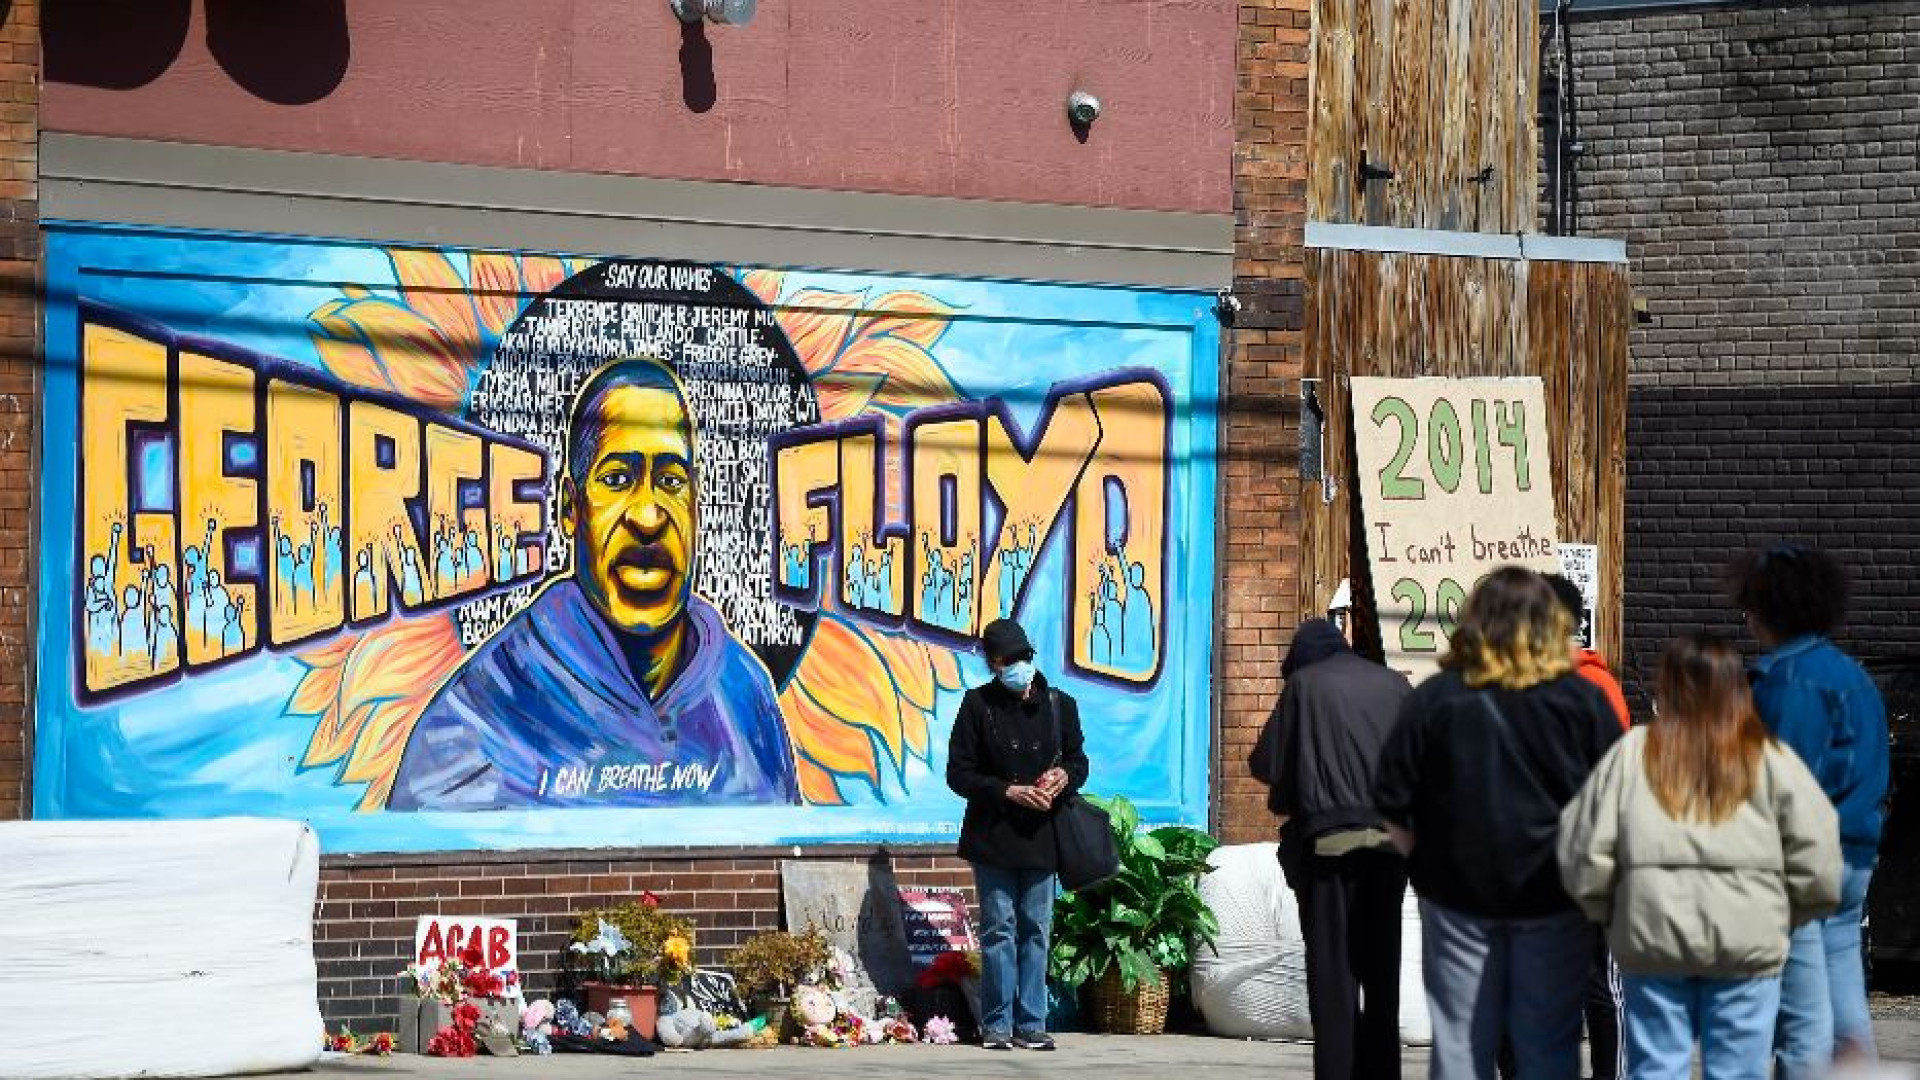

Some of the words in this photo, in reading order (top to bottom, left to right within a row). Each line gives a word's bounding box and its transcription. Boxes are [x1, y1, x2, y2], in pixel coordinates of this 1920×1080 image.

[605, 263, 636, 288] SAY
[638, 265, 669, 290] OUR
[670, 267, 712, 292] NAMES
[692, 305, 749, 327] JEREMY
[1370, 396, 1531, 500] 2014
[79, 312, 550, 698] GEORGE
[773, 374, 1171, 689] FLOYD
[1375, 522, 1397, 562] I
[1405, 532, 1456, 564] can't
[1471, 524, 1554, 561] breathe
[538, 769, 548, 797] I
[555, 766, 595, 796] CAN
[597, 761, 672, 792] BREATHE
[671, 761, 720, 792] NOW
[419, 919, 512, 970] ACAB
